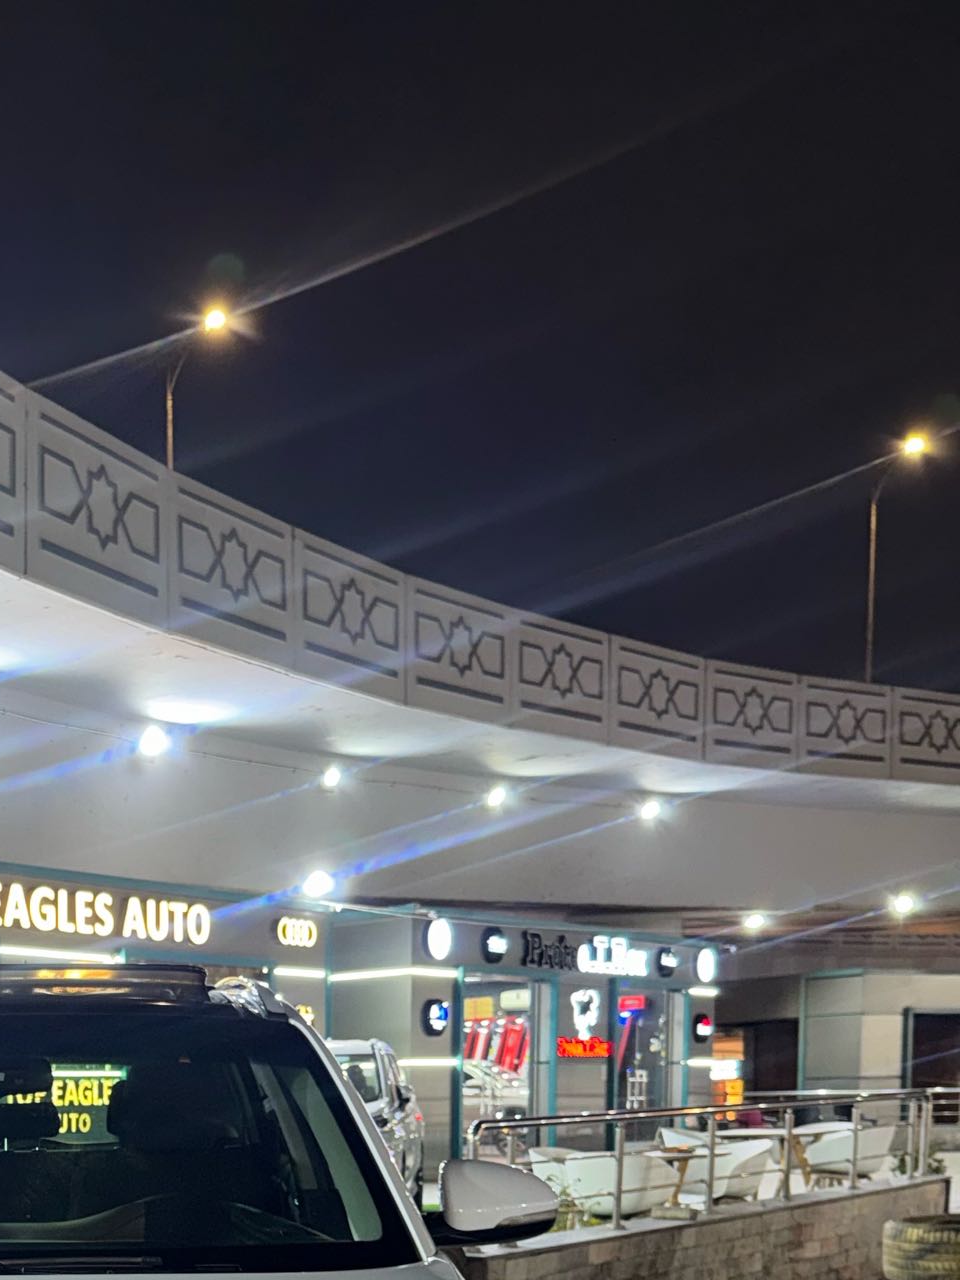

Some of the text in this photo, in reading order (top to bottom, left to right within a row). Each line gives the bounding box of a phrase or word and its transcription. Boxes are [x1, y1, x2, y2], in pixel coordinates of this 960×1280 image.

[122, 896, 211, 945] AUTO
[51, 1078, 120, 1106] EAGLE
[58, 1112, 91, 1133] UTO
